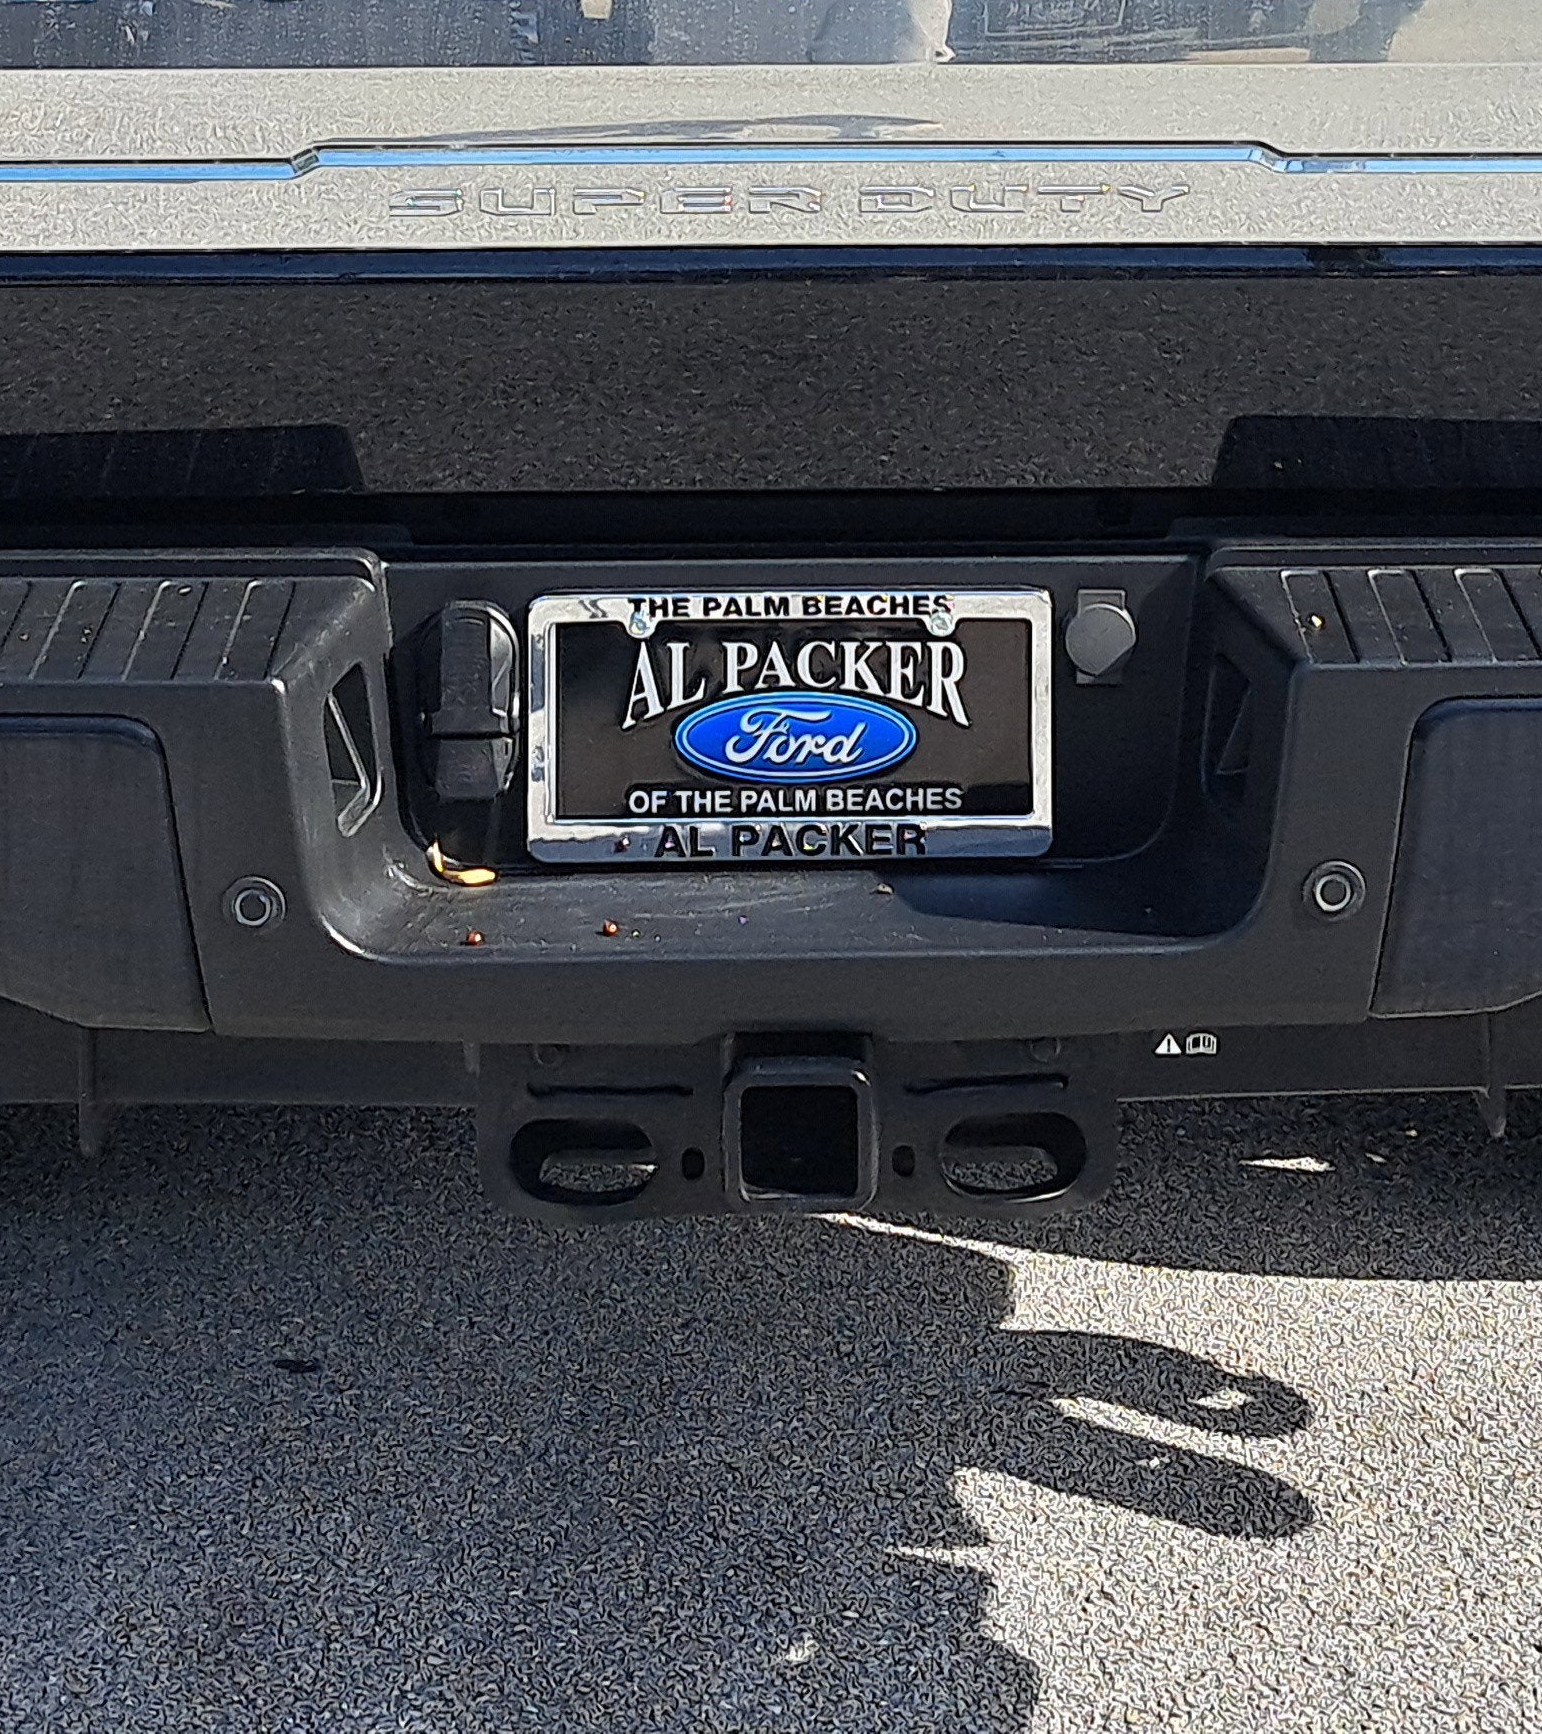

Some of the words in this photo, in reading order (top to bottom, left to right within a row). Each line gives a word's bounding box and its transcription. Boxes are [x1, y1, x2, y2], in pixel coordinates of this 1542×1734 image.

[388, 187, 823, 217] SUPER
[858, 184, 1192, 214] DUTY
[627, 597, 690, 617] THE
[703, 596, 790, 617] PALM
[802, 594, 953, 616] BEACHES
[622, 640, 706, 730] AL
[722, 639, 970, 727] PACKER
[725, 707, 864, 765] Ford
[628, 790, 668, 814] OF
[674, 789, 733, 814] THE
[740, 788, 817, 813] PALM
[826, 787, 963, 813] BEACHES
[654, 824, 716, 859] AL
[731, 822, 927, 858] PACKER
